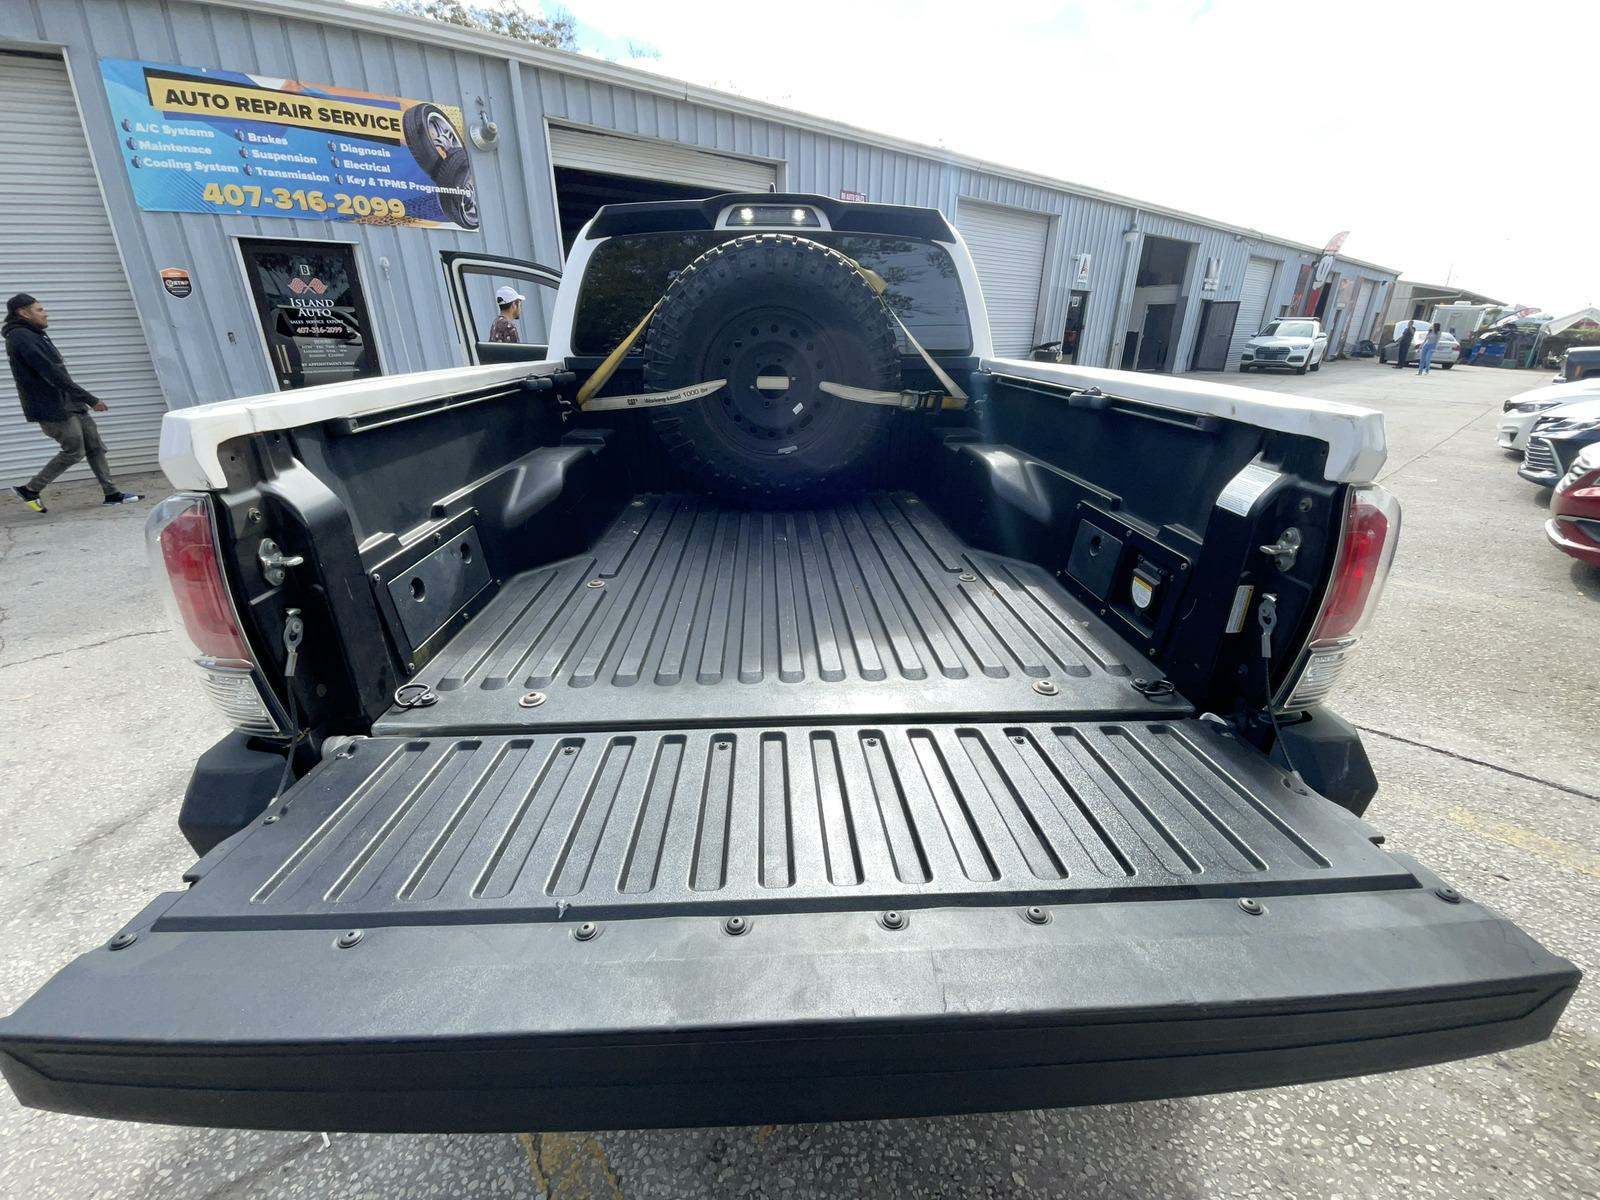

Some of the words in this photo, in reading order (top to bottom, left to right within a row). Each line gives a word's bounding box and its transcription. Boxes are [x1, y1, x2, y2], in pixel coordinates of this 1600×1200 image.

[165, 88, 230, 110] AUTO
[235, 95, 313, 121] REPAIR
[318, 107, 401, 133] SERVICE
[135, 121, 160, 134] A/C
[162, 124, 215, 138] Systems
[247, 132, 289, 146] Brakes
[139, 140, 213, 155] Maintenace
[339, 142, 392, 158] Diagnosis
[251, 148, 318, 165] Suspension
[143, 156, 192, 172] Cooling
[194, 160, 240, 174] System
[342, 159, 391, 174] Electrical
[255, 166, 330, 182] Transmission
[346, 174, 366, 187] Key
[368, 178, 376, 187] &
[377, 178, 408, 190] TPMS
[408, 181, 472, 198] Programming
[202, 182, 407, 218] 407-316-2099
[289, 297, 335, 308] ISLAND
[298, 307, 332, 317] AUTO
[296, 326, 343, 334] 407-316-2099
[683, 388, 700, 398] 1000
